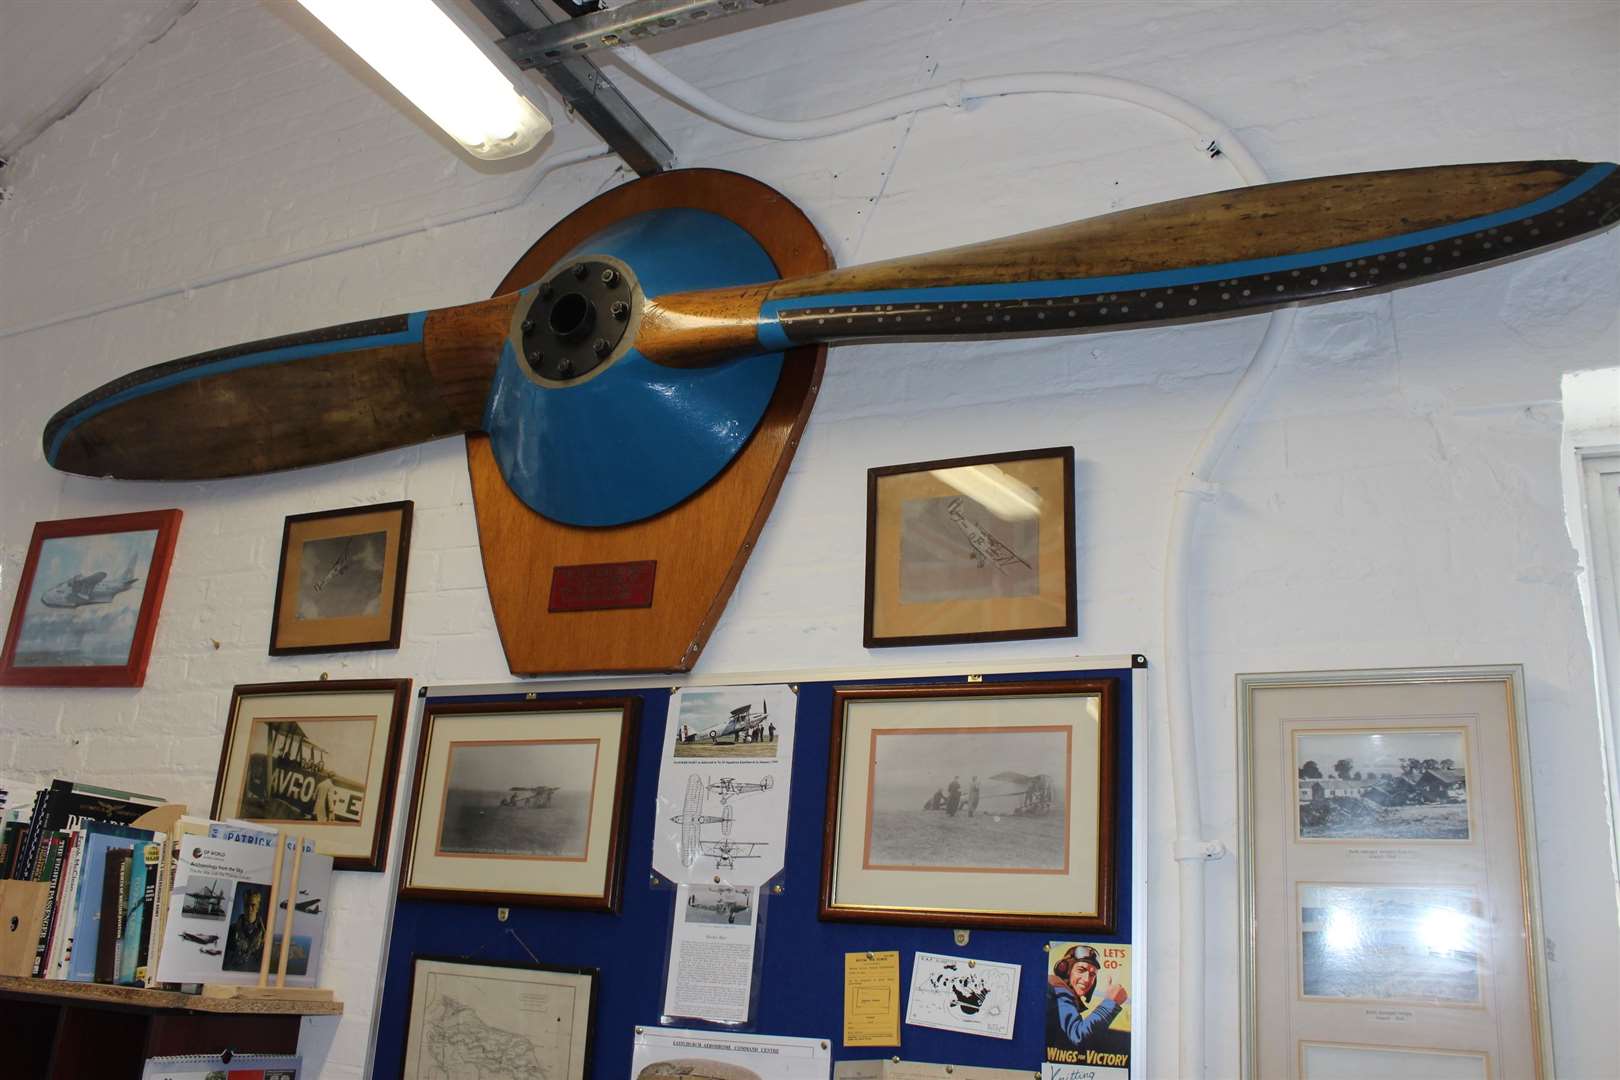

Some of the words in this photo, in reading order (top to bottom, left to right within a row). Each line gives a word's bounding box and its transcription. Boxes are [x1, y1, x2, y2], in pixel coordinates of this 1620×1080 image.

[271, 768, 315, 803] AVRO
[57, 840, 65, 857] THE
[40, 890, 54, 938] PASSENGER
[1104, 948, 1126, 958] LET'S
[1047, 1046, 1078, 1063] WINGS
[1086, 1050, 1128, 1067] VICTORY
